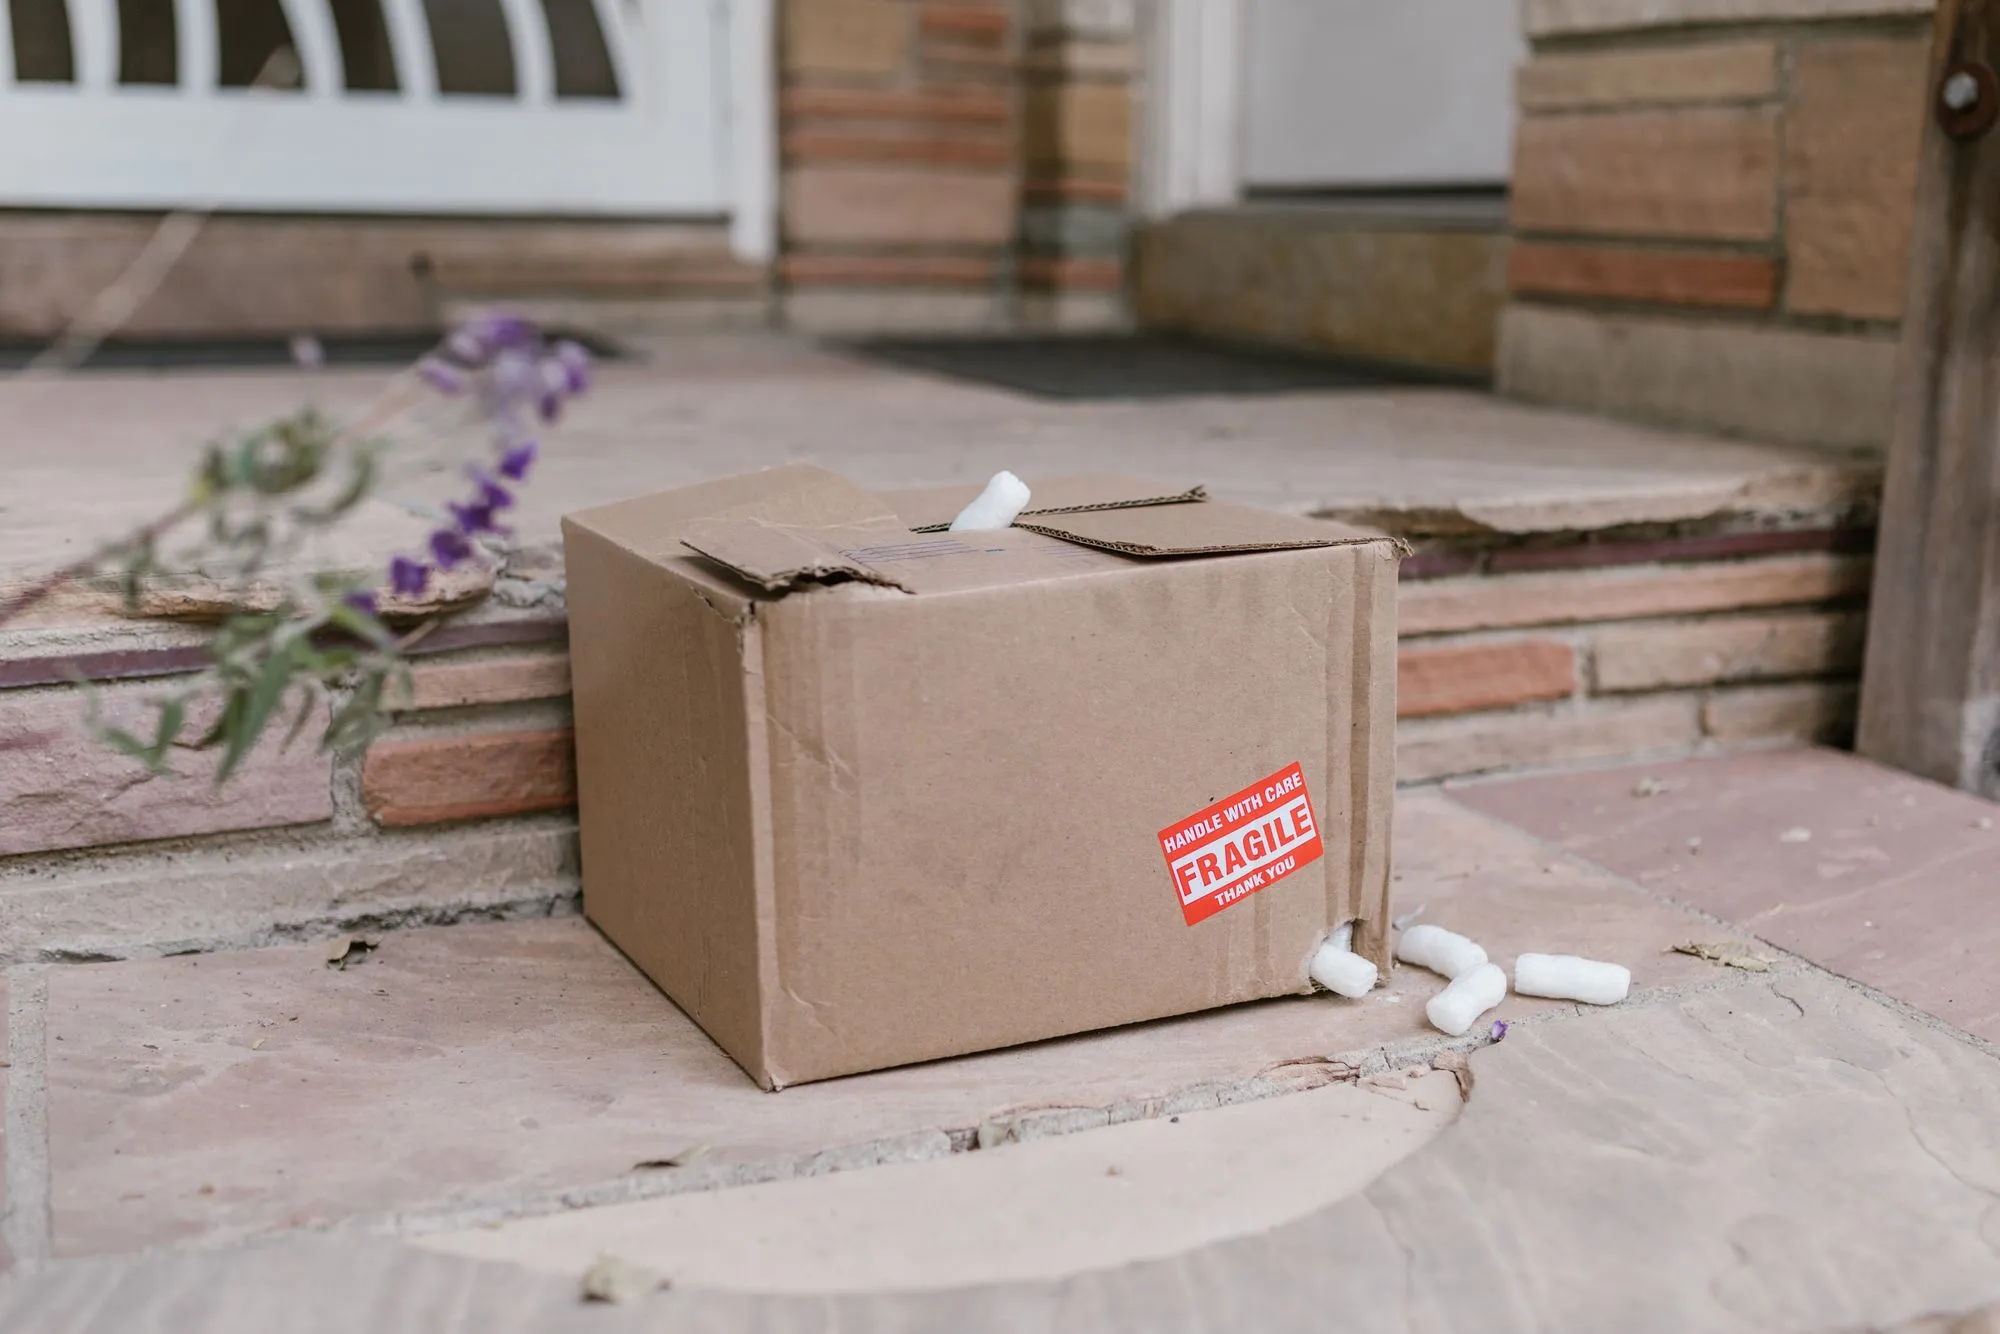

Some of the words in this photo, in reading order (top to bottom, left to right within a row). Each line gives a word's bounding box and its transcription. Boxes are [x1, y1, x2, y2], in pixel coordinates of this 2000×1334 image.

[1164, 813, 1223, 854] HANDLE
[1224, 794, 1263, 823] WITH
[1265, 772, 1302, 802] CARE
[1176, 803, 1311, 896] FRAGILE
[1215, 872, 1265, 906] THANK
[1266, 856, 1295, 878] YOU
